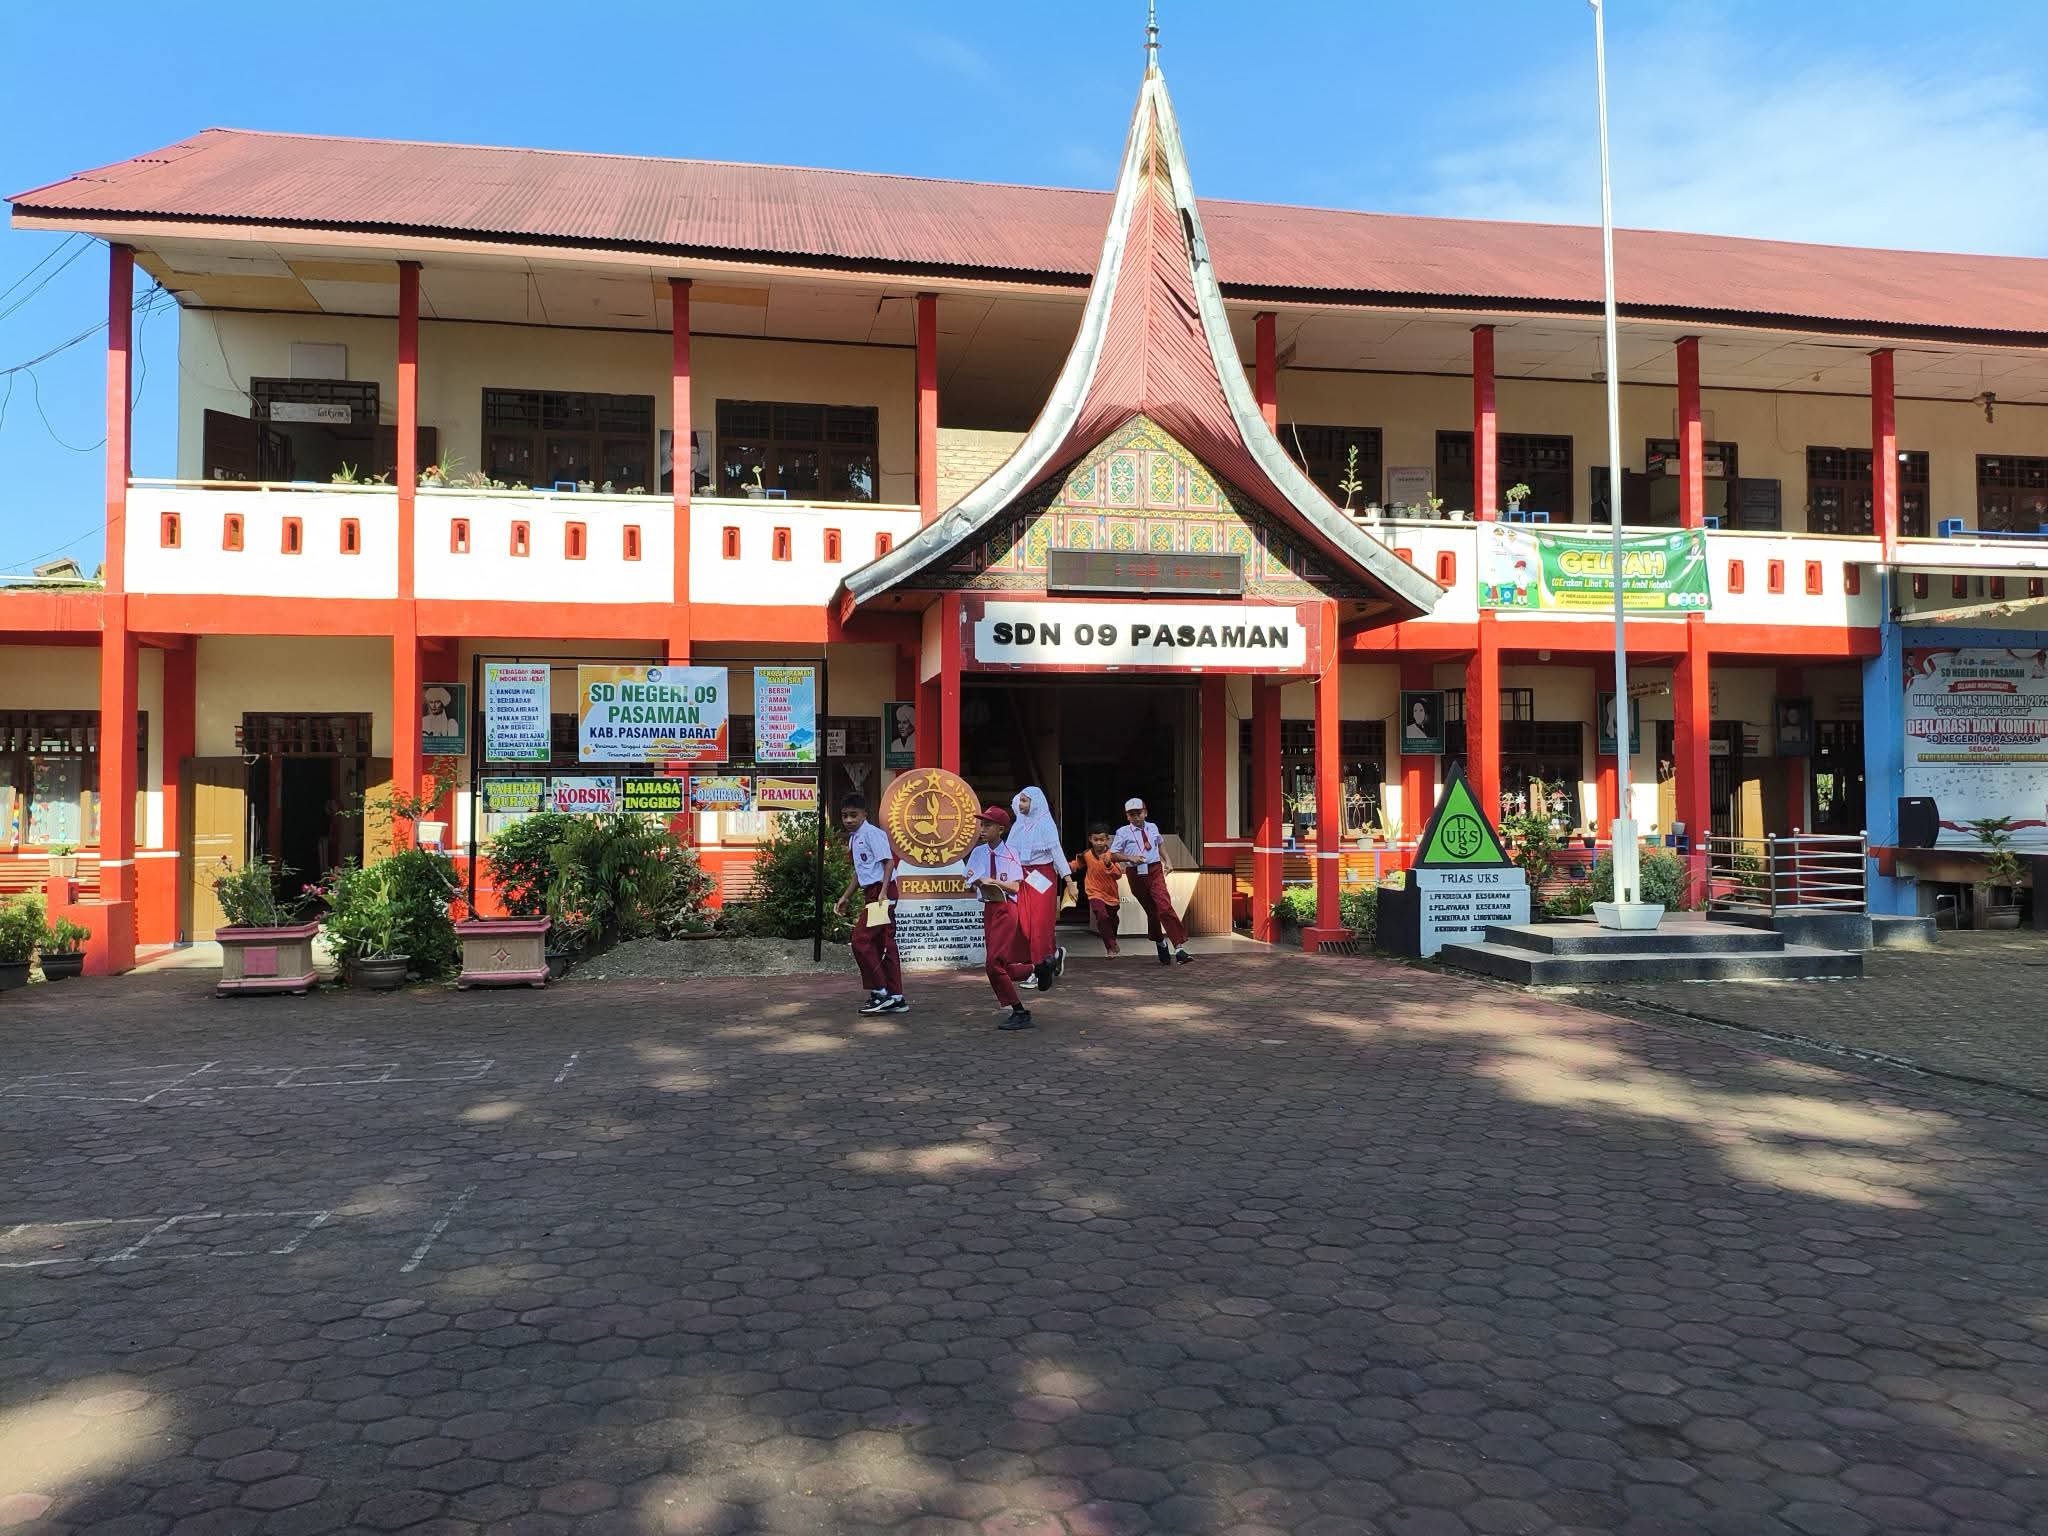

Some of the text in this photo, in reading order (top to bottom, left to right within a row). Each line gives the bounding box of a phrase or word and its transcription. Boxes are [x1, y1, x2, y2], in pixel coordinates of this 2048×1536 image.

[993, 623, 1288, 648] SDN 09 PASAMAN
[590, 685, 717, 704] SD NEGERI 09
[1913, 694, 1934, 707] HARI
[1936, 694, 1959, 707] GURU
[1960, 695, 2002, 708] NASIONAL
[2002, 695, 2028, 708] (HGN)
[608, 706, 700, 724] PASAMAN
[680, 728, 717, 738] BARAT
[1907, 719, 1970, 734] DEKLARASI
[1972, 719, 1997, 734] DAN
[1926, 734, 2040, 743] SD NEGERI 09 PASAMAN
[626, 783, 680, 794] BAHASA
[697, 788, 746, 802] OLAHRAGA
[761, 788, 814, 800] PRAMUKA
[558, 789, 611, 804] KORSIK
[626, 798, 680, 808] INGGRIS
[1445, 830, 1478, 844] UKS
[1440, 874, 1499, 884] TRIAS UKS
